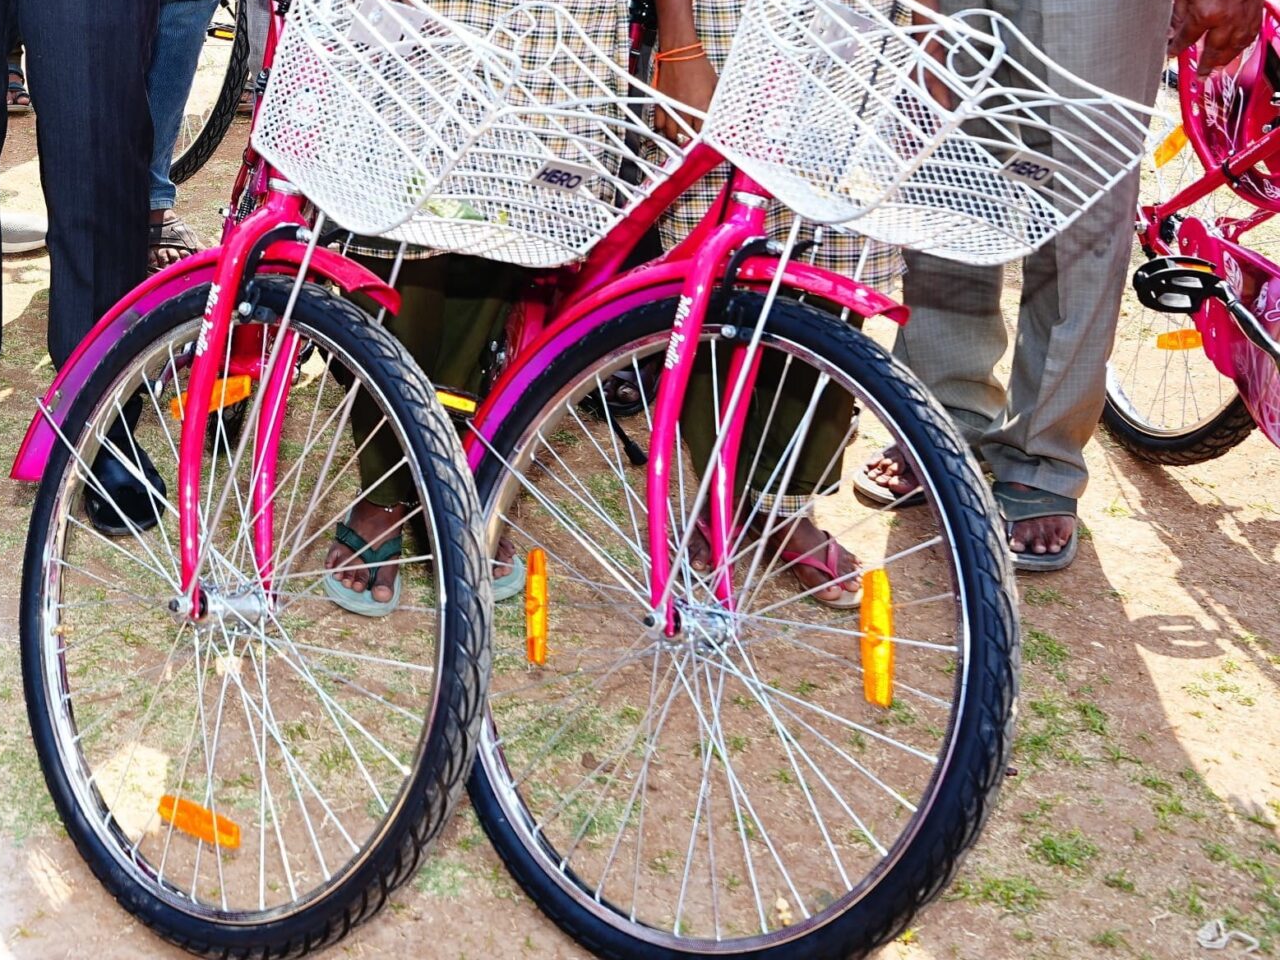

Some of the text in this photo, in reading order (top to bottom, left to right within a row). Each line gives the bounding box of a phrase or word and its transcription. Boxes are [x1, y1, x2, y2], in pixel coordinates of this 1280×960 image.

[539, 165, 582, 190] HERO
[1009, 157, 1052, 183] HERO
[664, 294, 693, 370] Miss India
